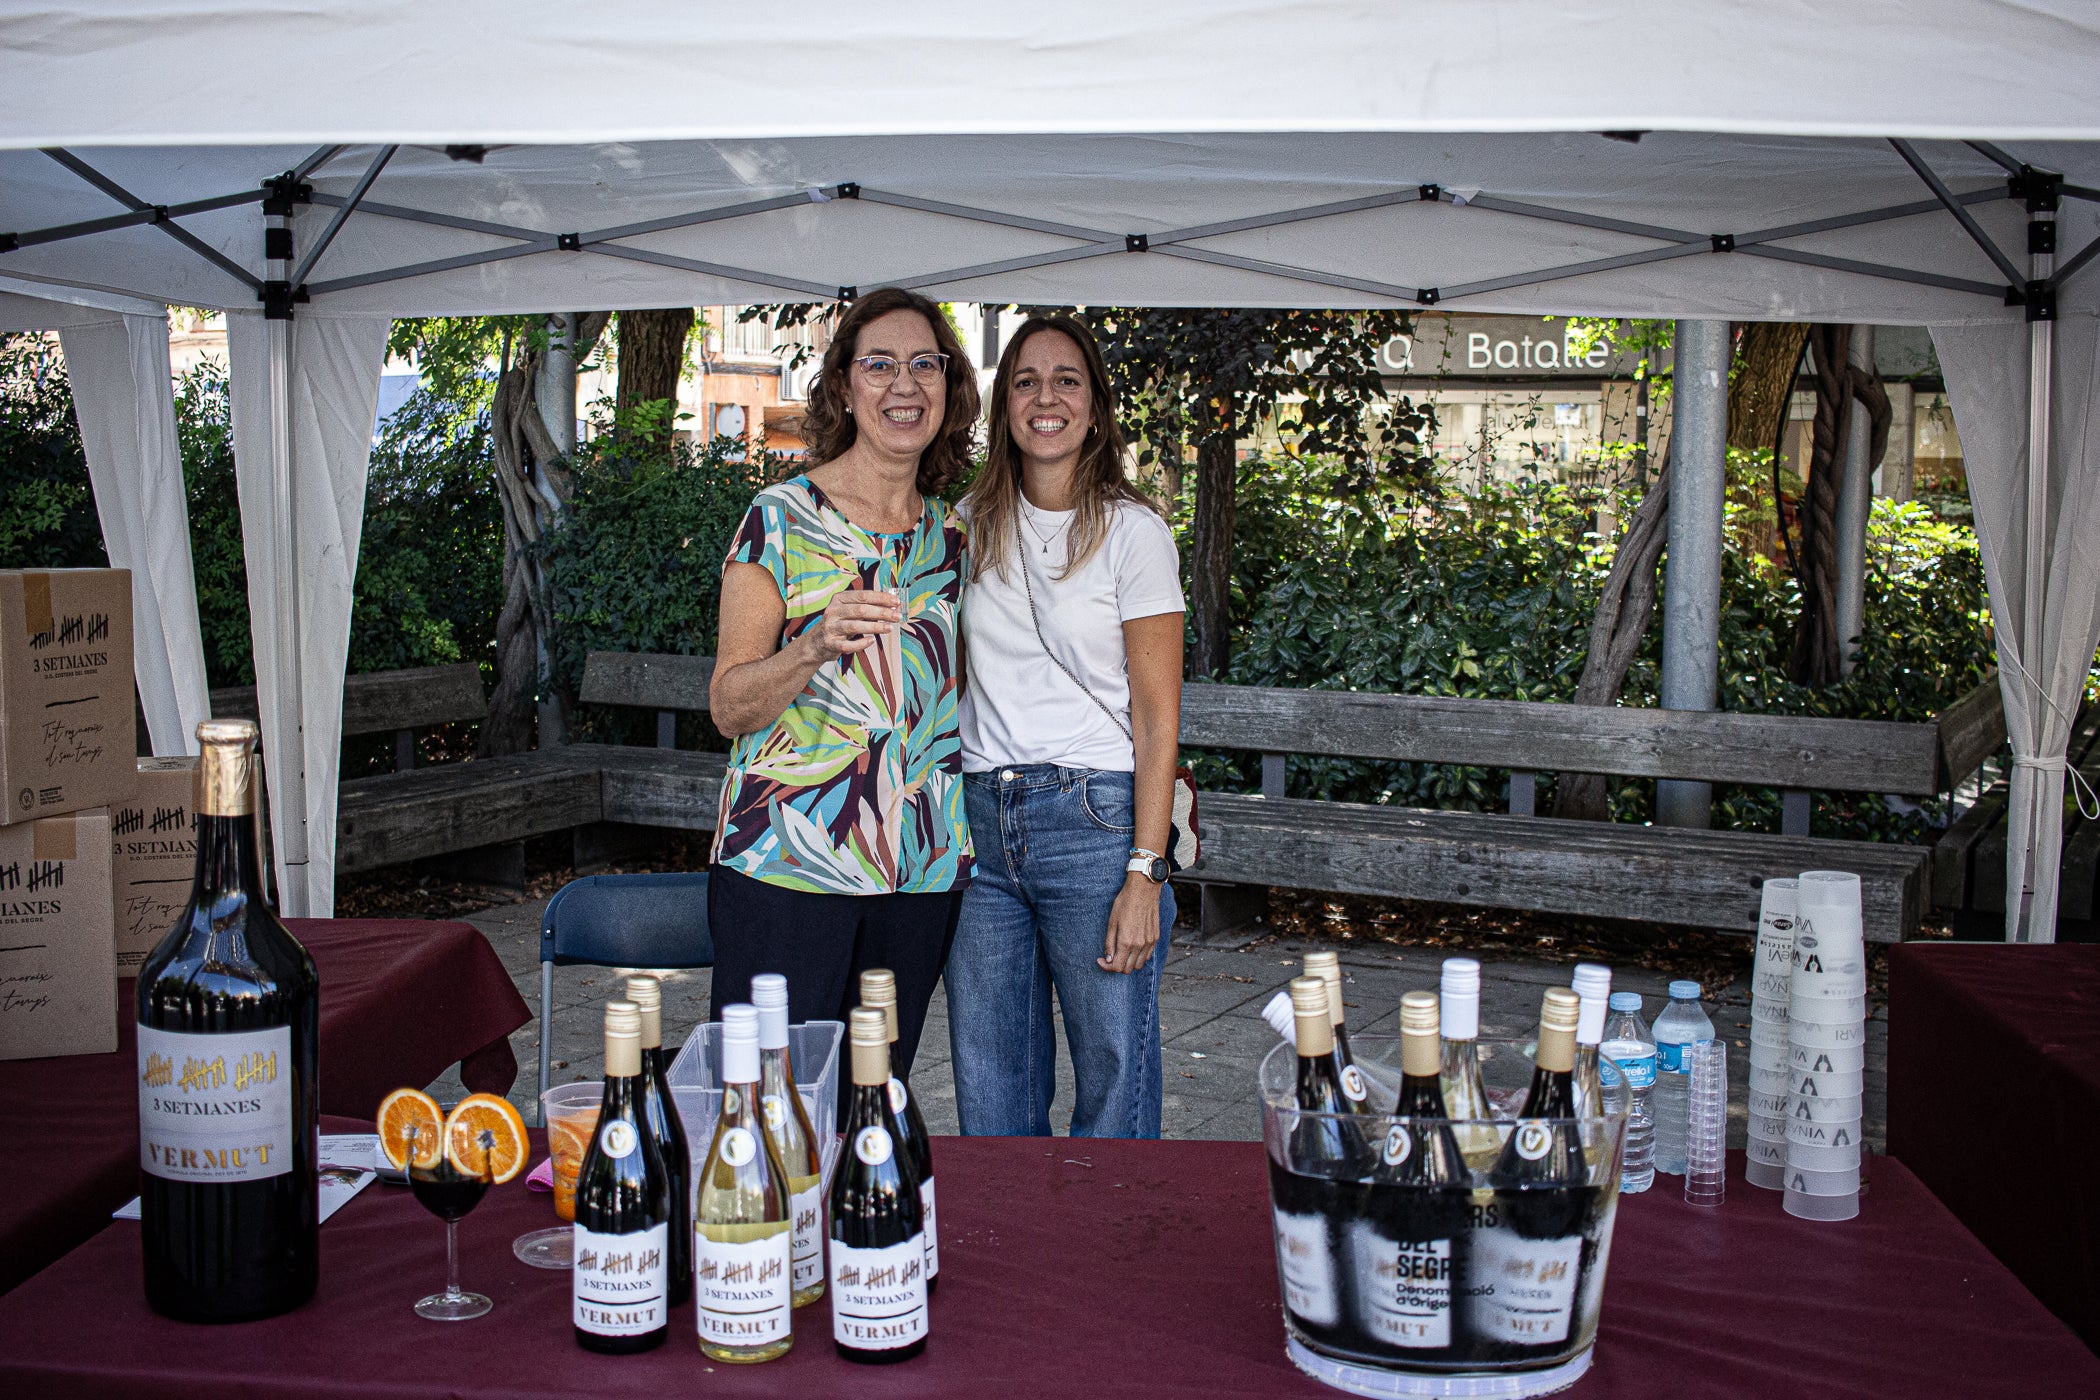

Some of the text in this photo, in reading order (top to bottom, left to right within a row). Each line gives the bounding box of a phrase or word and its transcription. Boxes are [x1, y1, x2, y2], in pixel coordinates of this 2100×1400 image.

[33, 652, 108, 673] 3 SETMANES
[114, 839, 198, 855] 3 SETMAN
[0, 900, 62, 917] ANES
[5, 916, 45, 925] DEL SEGRE
[152, 1097, 261, 1116] 3 SETMANES
[148, 1142, 274, 1170] VERMUT
[1396, 1254, 1461, 1281] SEGR
[590, 1279, 653, 1292] SETMANES
[1396, 1283, 1496, 1298] Denomació
[711, 1288, 774, 1301] SETMANES
[853, 1290, 916, 1305] SETMANES
[1396, 1296, 1451, 1311] d'Orige
[580, 1306, 657, 1325] VERMUT
[702, 1316, 780, 1334] VERMUT
[842, 1318, 920, 1339] VERMUT
